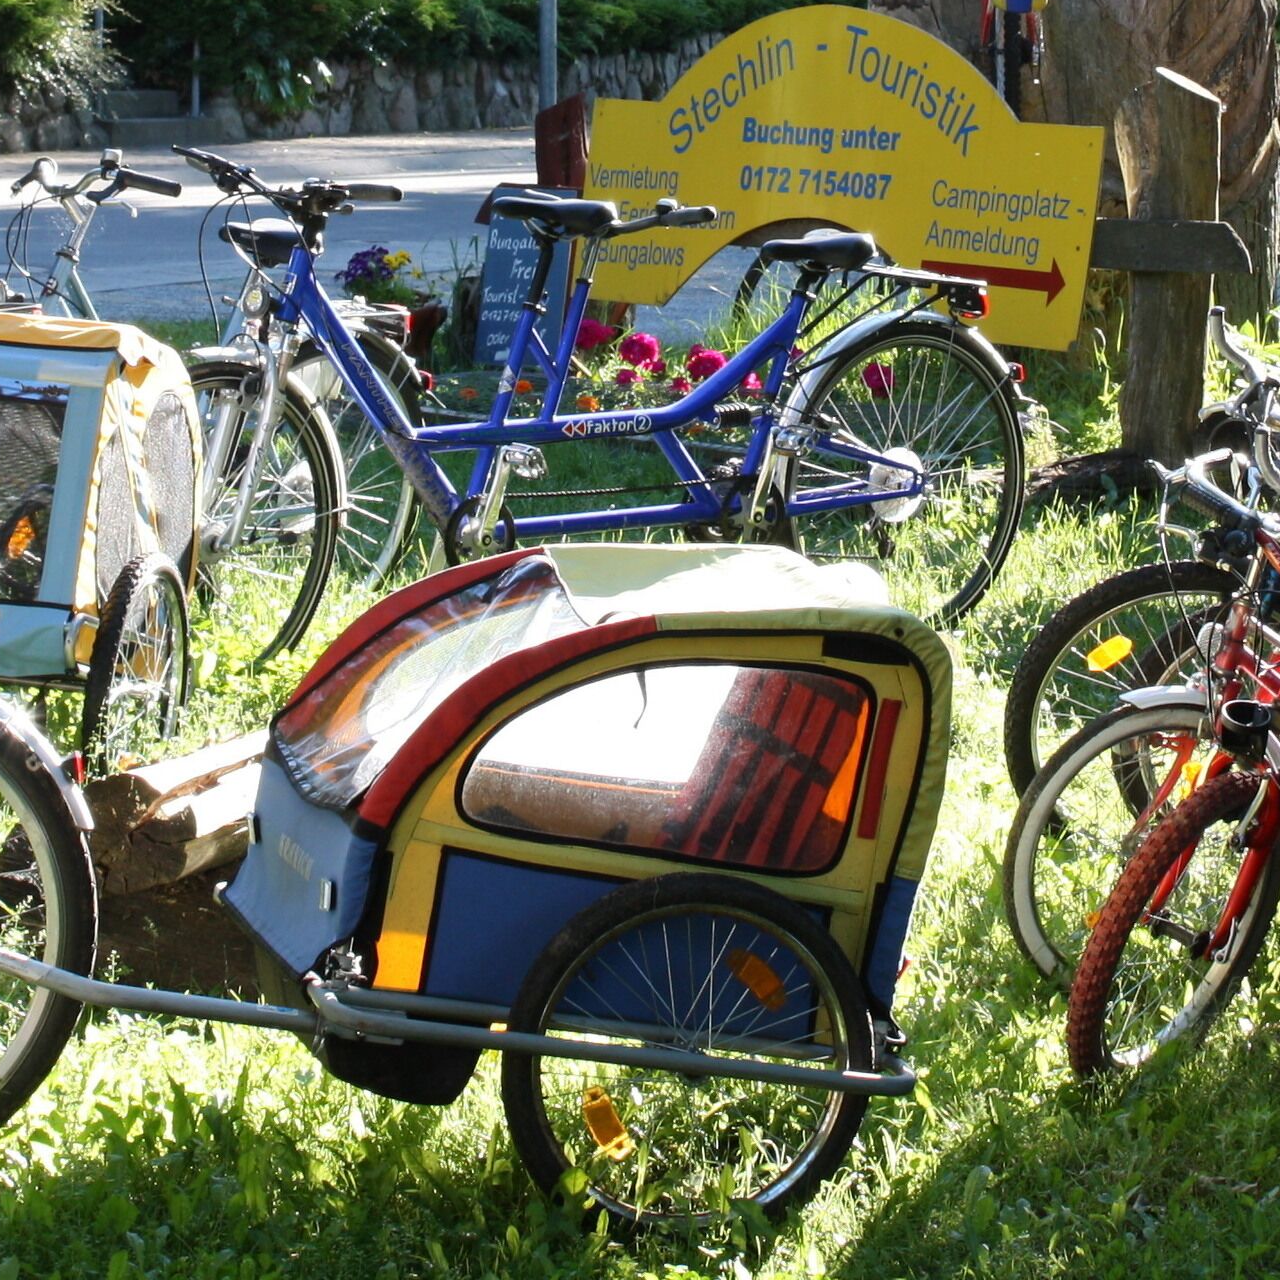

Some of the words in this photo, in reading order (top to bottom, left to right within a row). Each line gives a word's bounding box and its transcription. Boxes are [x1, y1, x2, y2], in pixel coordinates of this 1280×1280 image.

[669, 35, 795, 155] Stechlin
[846, 24, 981, 158] Touristik
[741, 116, 835, 154] Buchung
[841, 124, 902, 152] unter
[589, 162, 680, 197] Vermietung
[740, 164, 792, 194] 0172
[798, 167, 893, 200] 7154087
[931, 179, 1072, 223] Campingplatz
[597, 238, 685, 271] Bungalows
[924, 219, 1041, 266] Anmeldung
[586, 418, 634, 435] faktor
